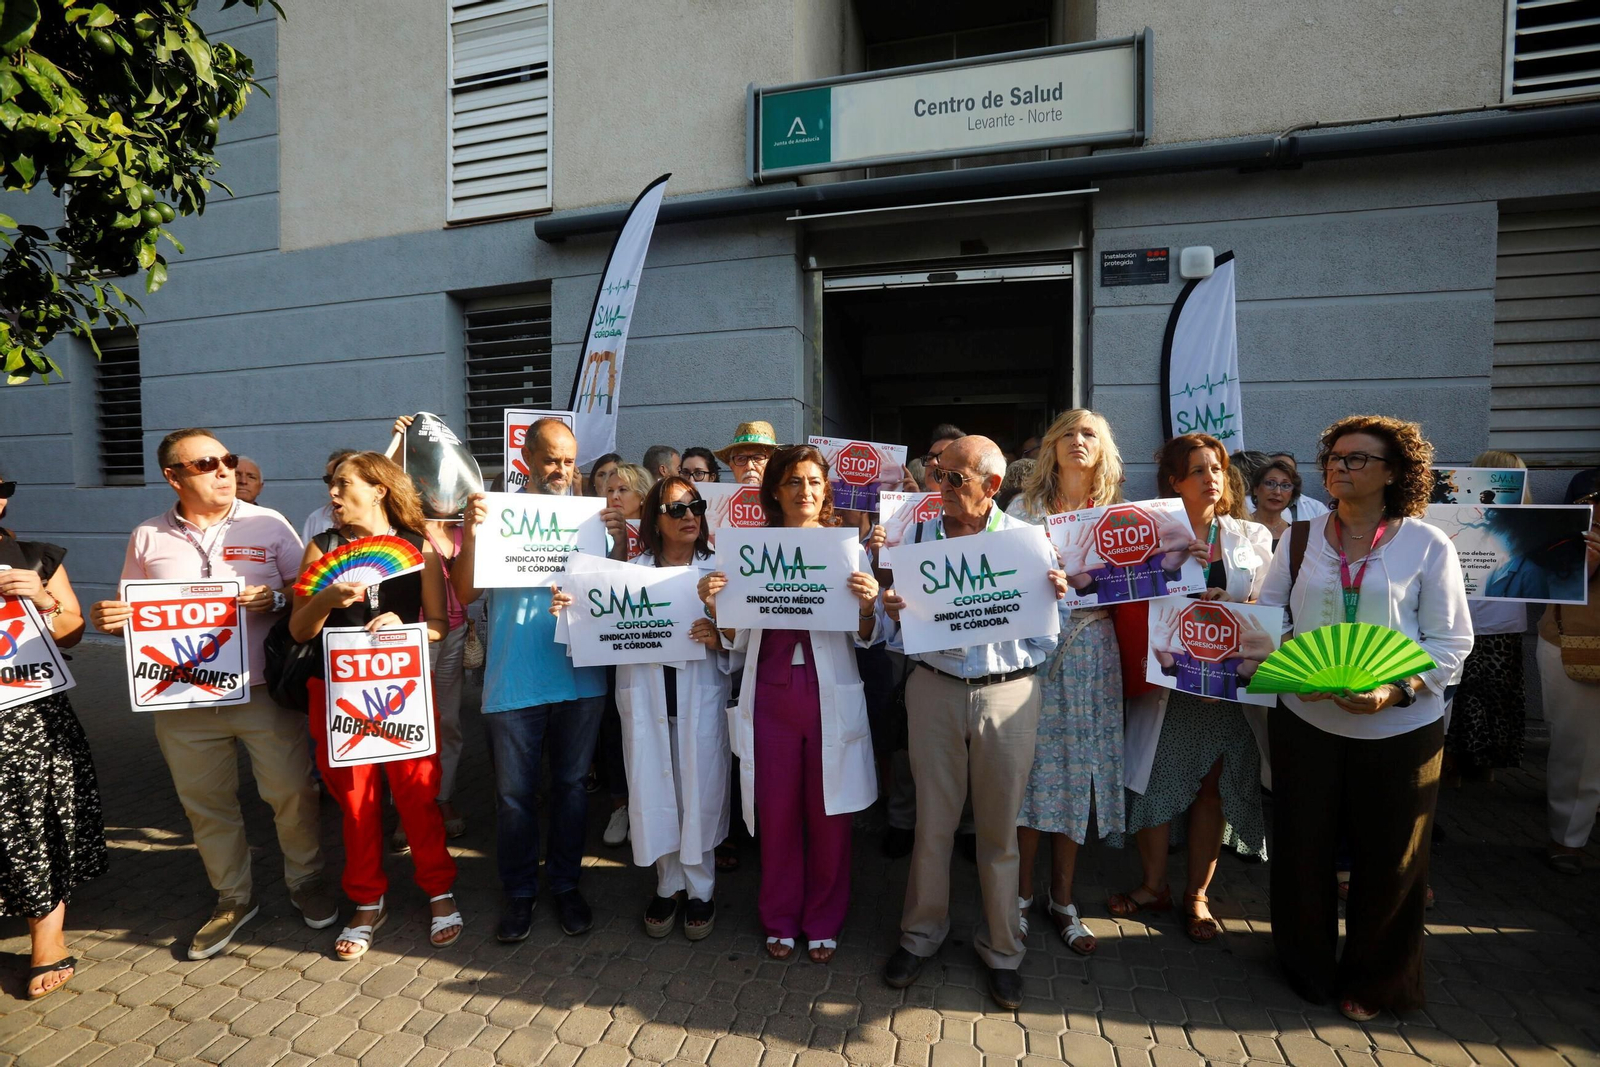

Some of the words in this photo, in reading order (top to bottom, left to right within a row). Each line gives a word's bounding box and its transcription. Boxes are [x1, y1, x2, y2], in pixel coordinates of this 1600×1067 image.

[914, 99, 975, 117] Centro
[982, 90, 1004, 110] de
[1010, 82, 1063, 106] Salud
[968, 114, 1015, 130] Levante
[1028, 108, 1062, 124] Norte
[850, 448, 869, 458] SAS
[842, 457, 876, 472] STOP
[500, 508, 579, 542] SMA
[1050, 515, 1067, 525] UGT
[1110, 513, 1138, 527] SAS
[1102, 525, 1150, 548] STOP
[1107, 544, 1150, 555] AGRESIONES
[528, 564, 566, 572] CÓRDOBA
[740, 542, 827, 581] SMA
[919, 552, 1017, 594] SMA
[765, 583, 828, 592] CORDOBA
[588, 584, 671, 620] SMA
[746, 596, 790, 604] SINDICATO
[792, 595, 824, 604] MÉDICO
[953, 588, 1022, 606] CORDOBA
[139, 602, 227, 627] STOP
[771, 605, 813, 615] CÓRDOBA
[934, 608, 982, 622] SINDICATO
[984, 603, 1020, 616] MÉDICO
[1192, 609, 1222, 621] SAS
[616, 619, 674, 629] CORDOBA
[950, 622, 962, 632] DE
[963, 617, 1009, 630] CÓRDOBA
[1184, 621, 1232, 643] STOP
[600, 632, 641, 642] SINDICATO
[641, 629, 672, 639] MÉDICO
[624, 640, 663, 649] CÓRDOBA
[171, 633, 220, 668] NO
[1186, 640, 1228, 651] AGRESIONES
[336, 652, 411, 679] STOP
[134, 662, 239, 690] AGRESIONES
[362, 684, 406, 722] NO
[331, 715, 425, 742] AGRESIONES
